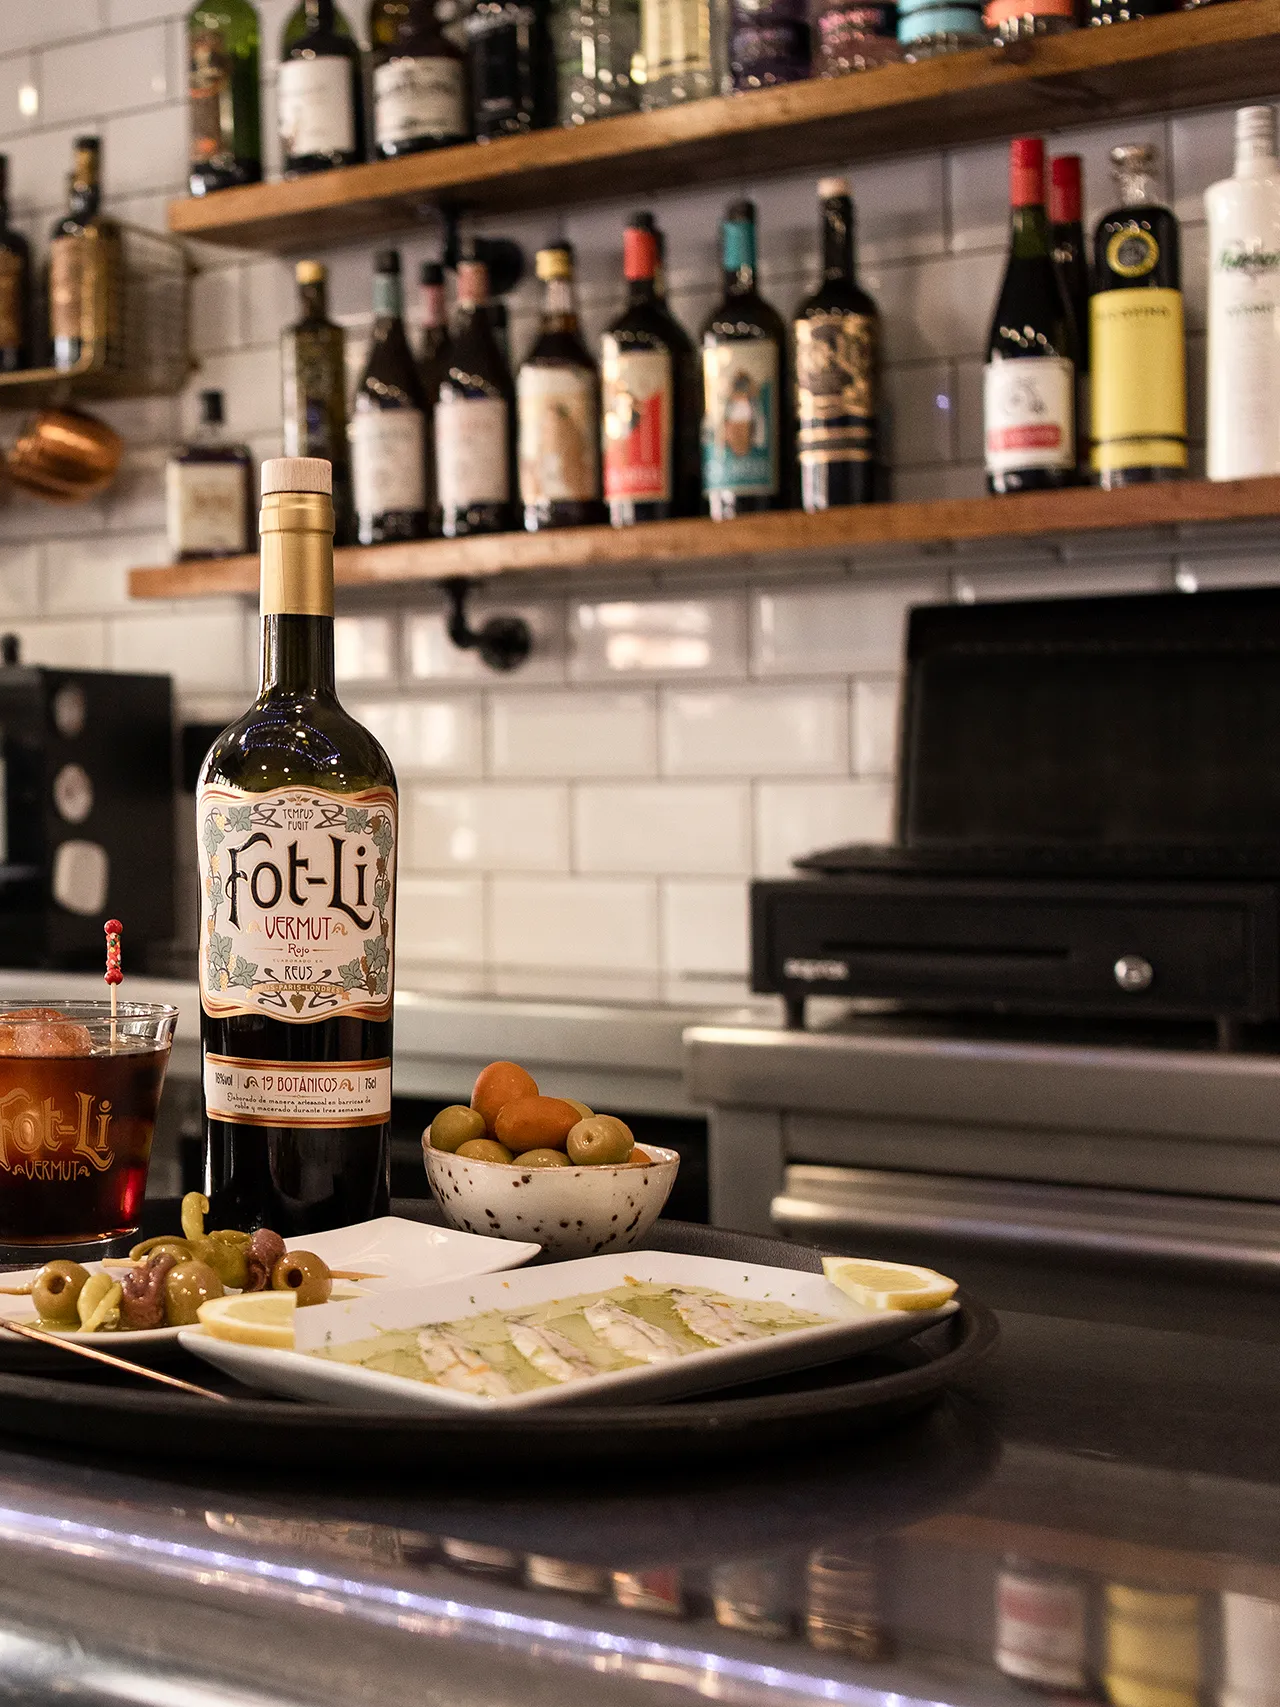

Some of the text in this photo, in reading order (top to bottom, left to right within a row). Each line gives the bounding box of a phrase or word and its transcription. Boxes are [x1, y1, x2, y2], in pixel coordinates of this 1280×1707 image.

[282, 808, 314, 819] TEMPUS
[287, 822, 309, 831] FUGIT
[225, 832, 375, 931] Fot-Li
[264, 916, 332, 940] VERMUT
[287, 943, 310, 957] Rojo
[284, 966, 313, 981] REUS
[261, 1076, 274, 1091] 19
[277, 1075, 338, 1093] BOTÁNICOS
[364, 1077, 377, 1090] 75cl
[227, 1091, 257, 1103] Elaborado
[258, 1096, 266, 1104] de
[338, 1097, 364, 1105] barricas
[364, 1096, 371, 1104] de
[234, 1101, 250, 1110] roble
[251, 1105, 256, 1113] y
[293, 1105, 320, 1113] durante
[24, 1160, 80, 1181] VERMUT
